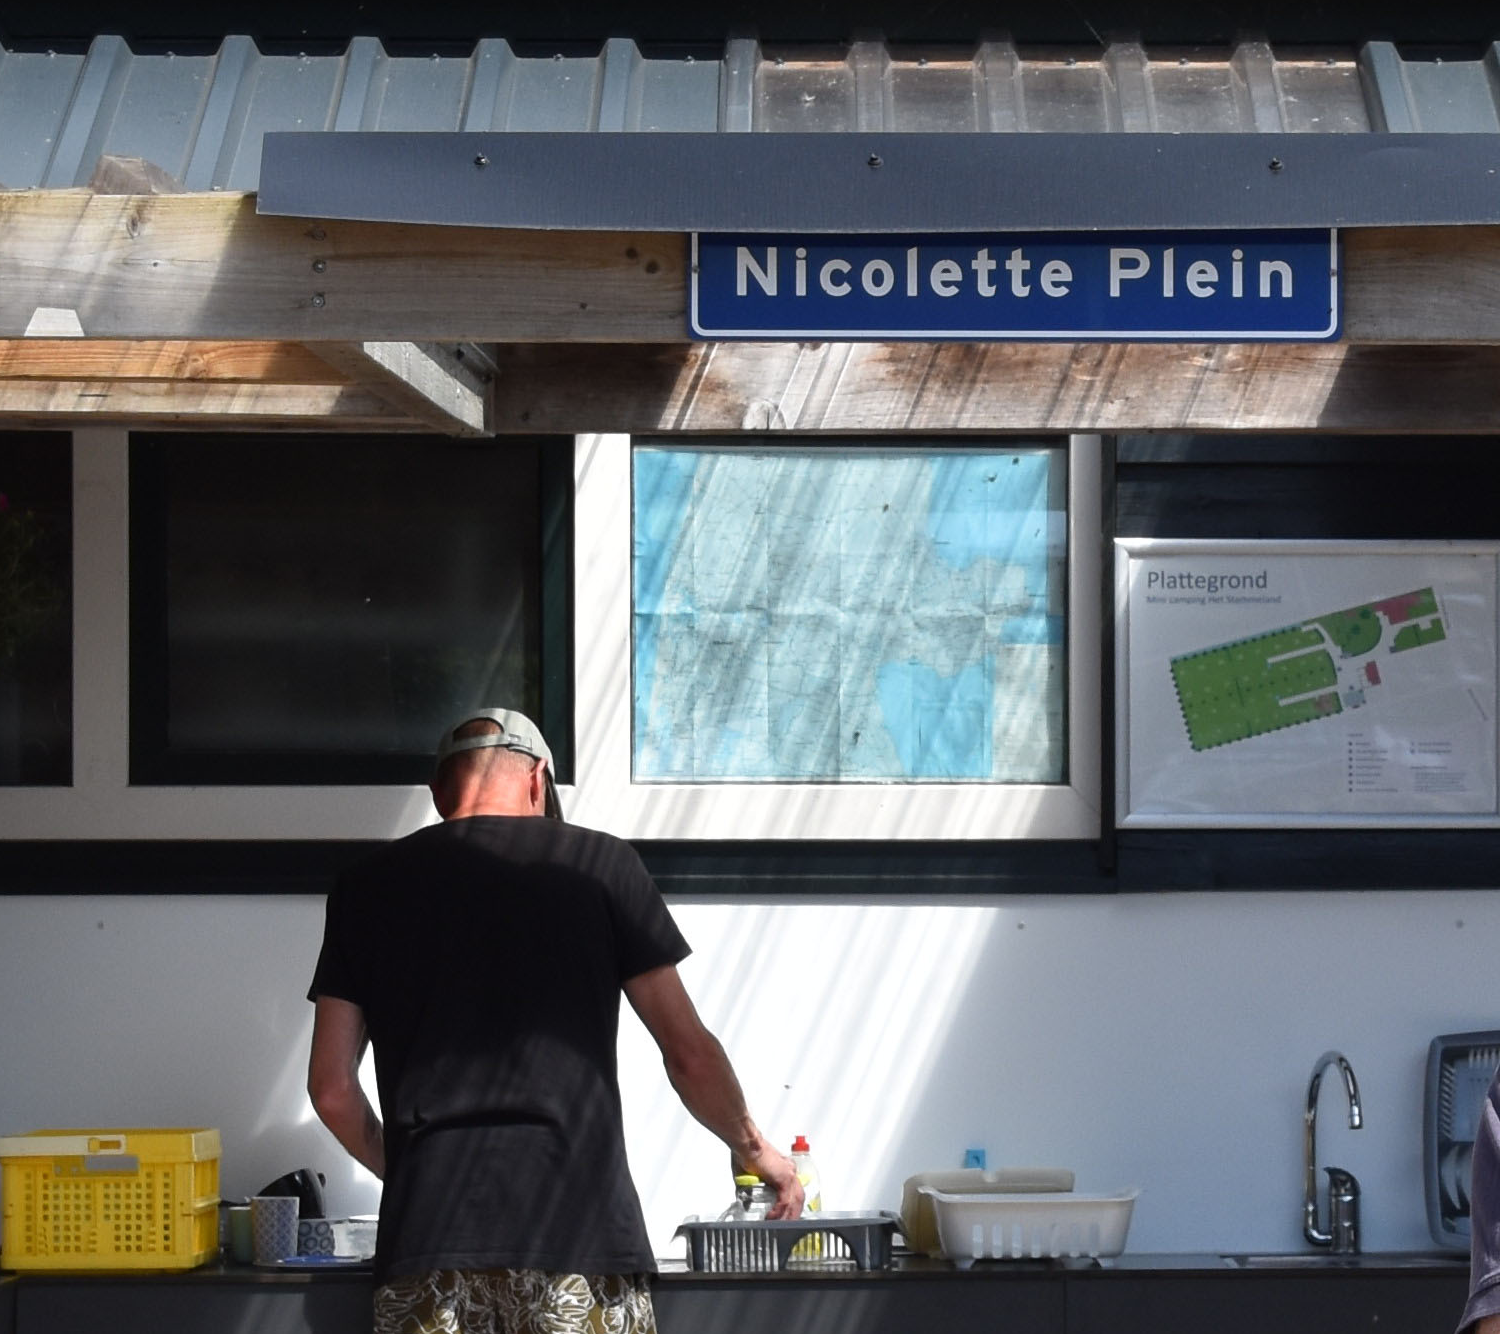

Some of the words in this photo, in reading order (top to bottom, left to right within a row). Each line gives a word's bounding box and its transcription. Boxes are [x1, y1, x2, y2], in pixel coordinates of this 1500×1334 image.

[736, 246, 1074, 298] Nicolette
[1108, 247, 1294, 299] Plein
[1147, 570, 1268, 594] Plattegrond
